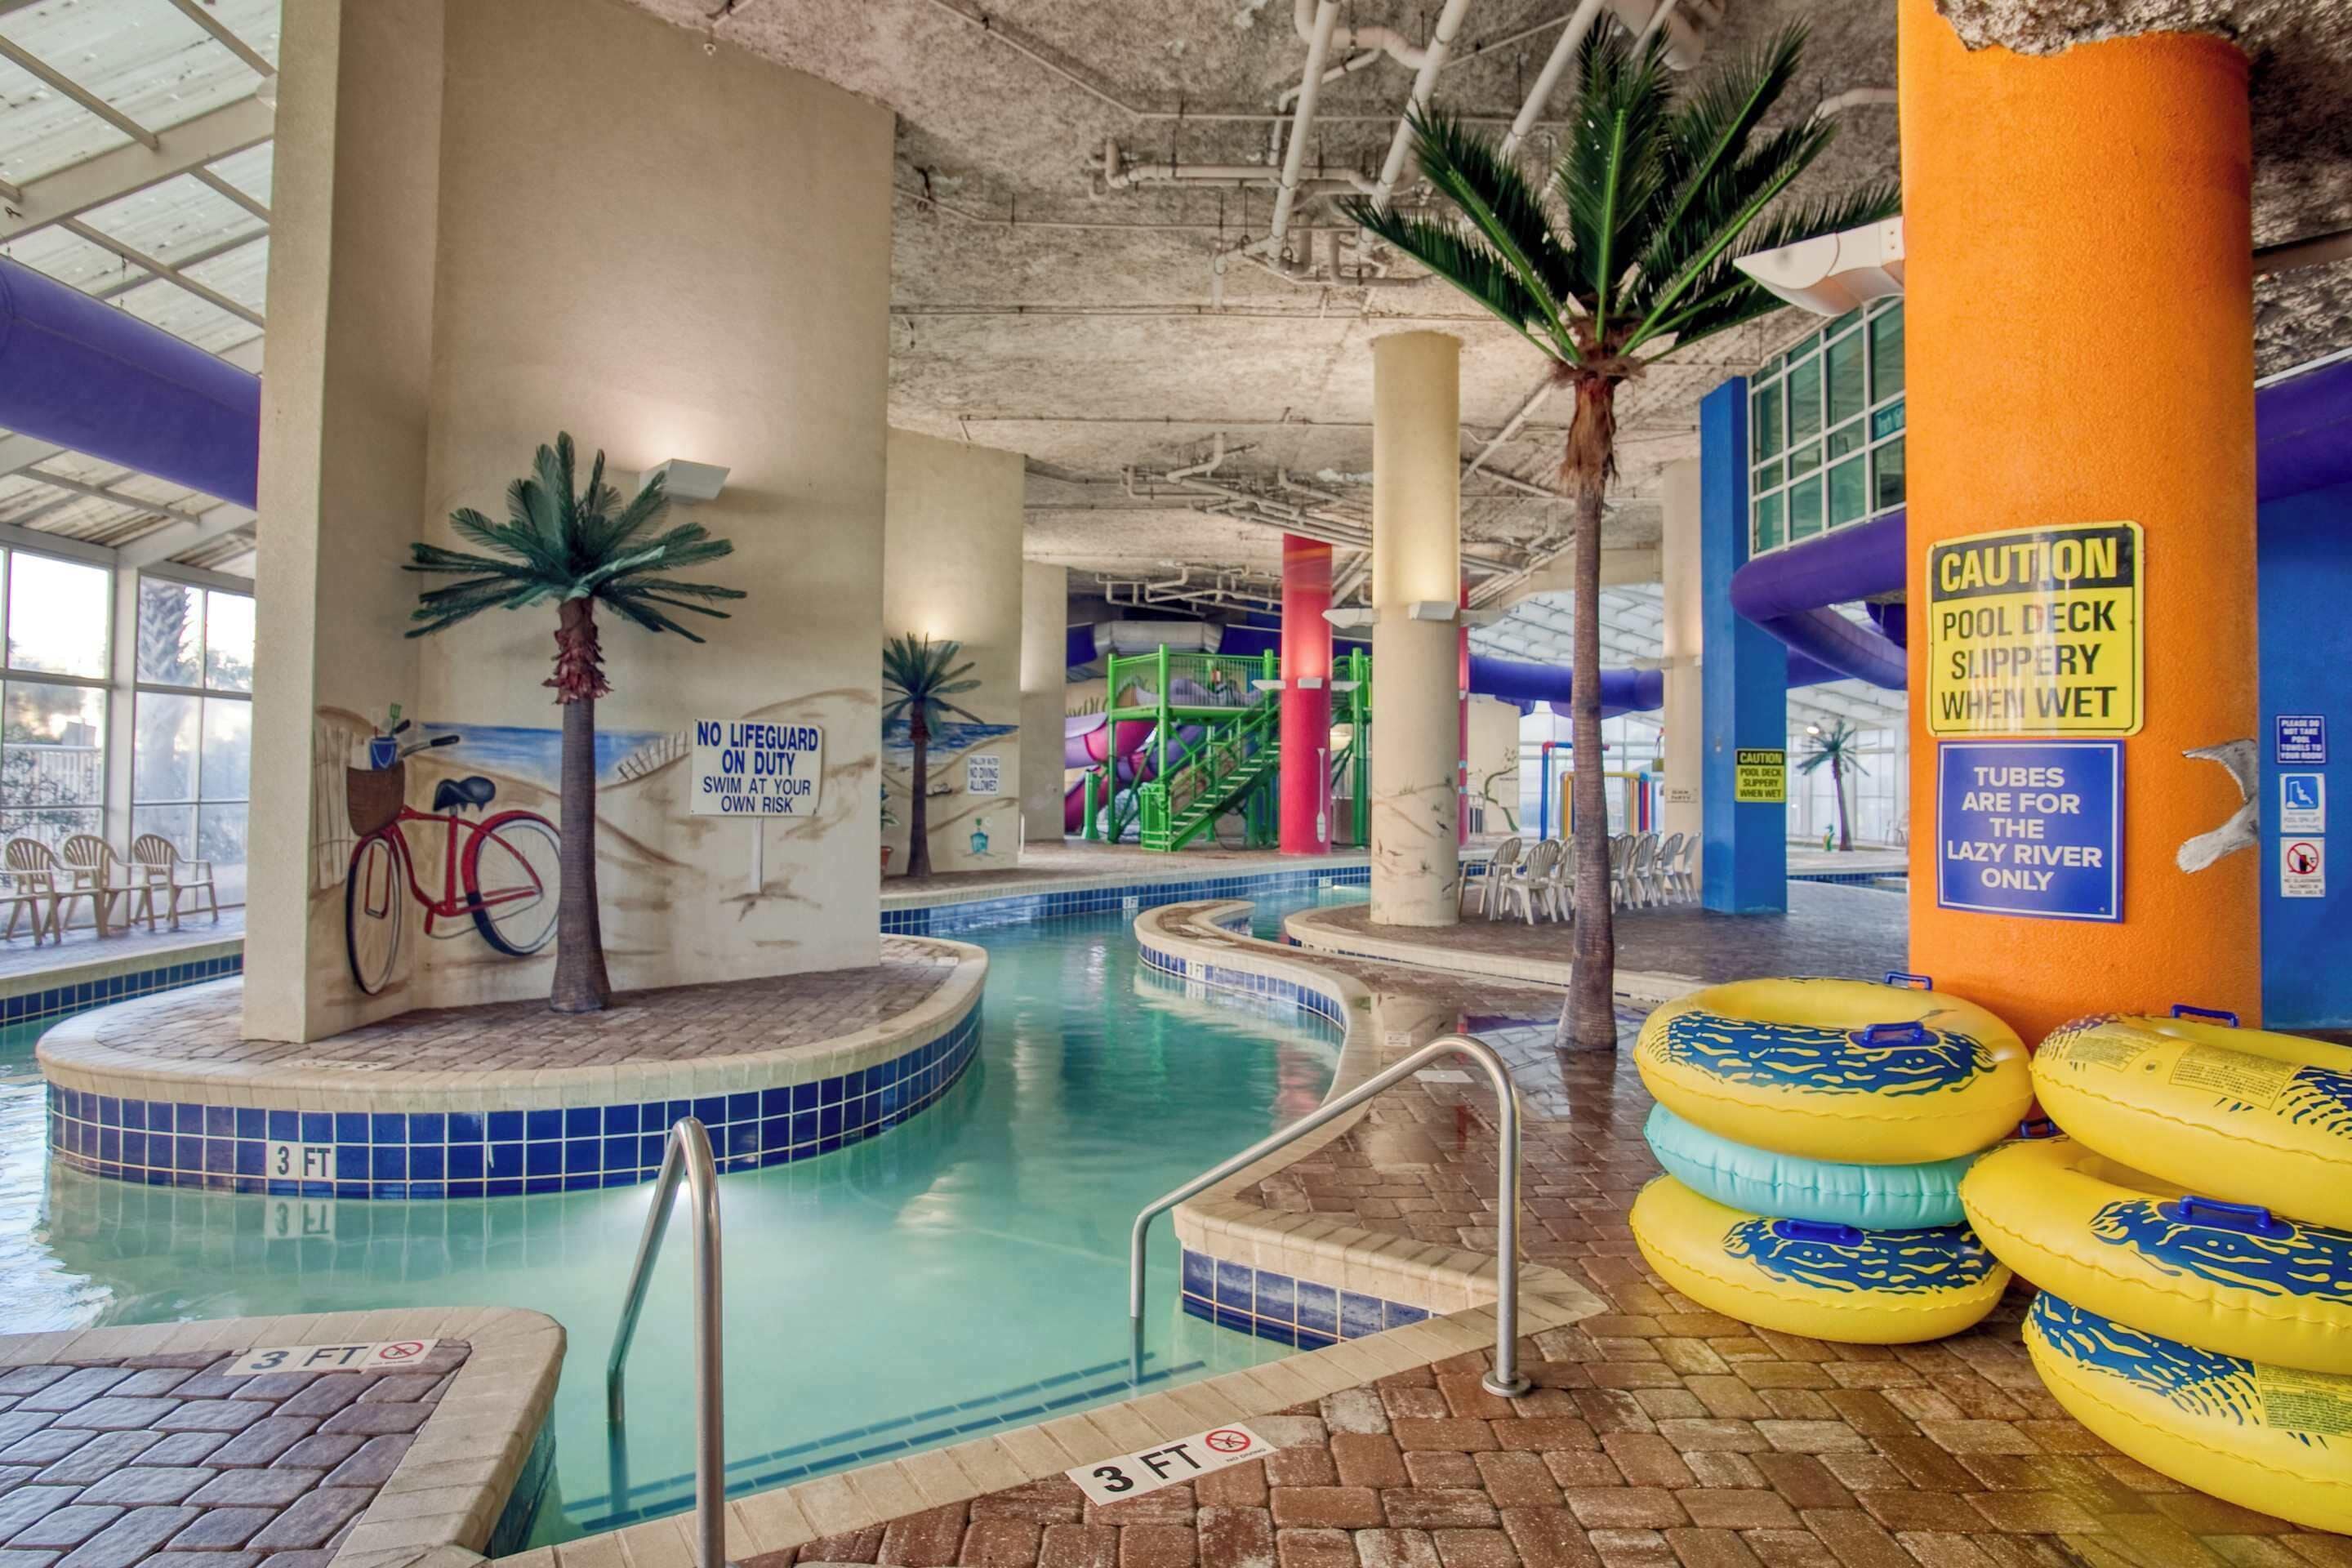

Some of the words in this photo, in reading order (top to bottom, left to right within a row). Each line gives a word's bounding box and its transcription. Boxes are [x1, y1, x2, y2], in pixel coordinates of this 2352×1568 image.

[1940, 537, 2118, 593] CAUTION
[1943, 606, 2012, 641] POOL
[2022, 600, 2117, 635] DECK
[1951, 644, 2102, 679] SLIPPERY
[1941, 688, 2025, 720] WHEN
[2034, 686, 2118, 719] WET
[697, 721, 722, 746] NO
[730, 723, 818, 751] LIFEGUARD
[722, 749, 745, 774] ON
[754, 751, 795, 776] DUTY
[1740, 752, 1782, 764] CAUTION
[979, 767, 999, 778] DIVING
[1740, 768, 1759, 777] POOL
[1762, 768, 1782, 777] DECK
[1743, 778, 1779, 787] SLIPPERY
[1973, 766, 2065, 788] TUBES
[703, 776, 742, 794] SWIM
[748, 777, 768, 795] AT
[774, 778, 811, 795] YOUR
[1740, 789, 1763, 797] WHEN
[1765, 789, 1782, 797] WET
[721, 795, 755, 813] OWN
[762, 796, 794, 813] RISK
[1962, 791, 2011, 812] ARE
[2020, 793, 2081, 815] FOR
[1989, 817, 2044, 840] THE
[1948, 840, 2007, 863] LAZY
[2014, 844, 2103, 868] RIVER
[1980, 867, 2055, 891] ONLY
[277, 1146, 290, 1175] 3
[303, 1147, 331, 1177] FT
[250, 1351, 289, 1370] 3
[303, 1346, 369, 1367] FT
[1093, 1466, 1134, 1493] 3
[1138, 1443, 1201, 1480] FT
